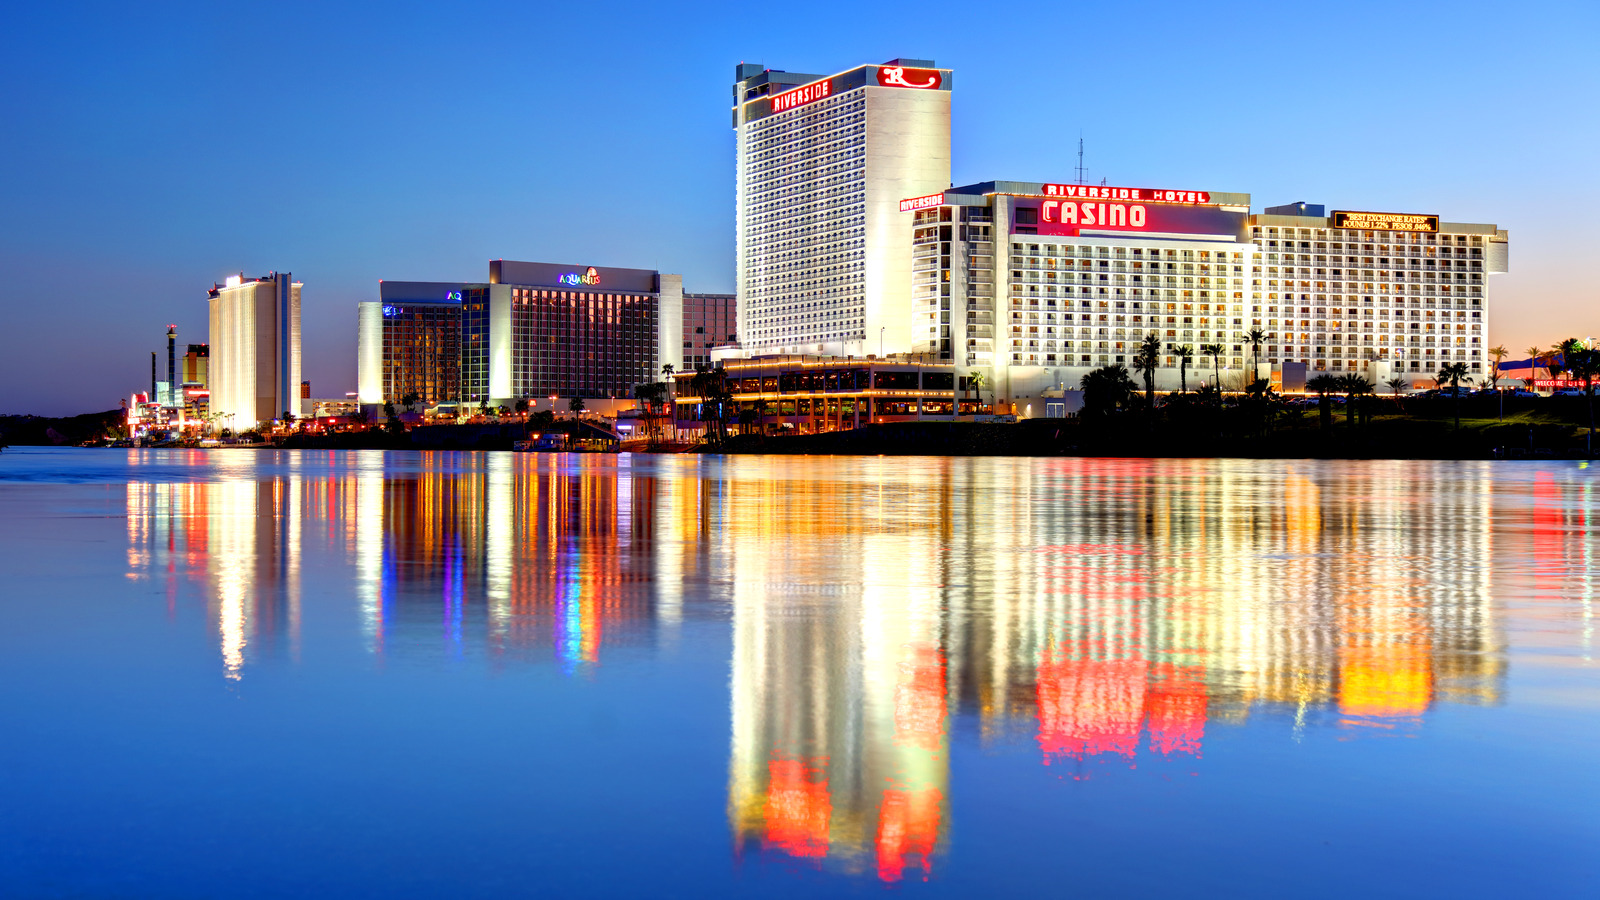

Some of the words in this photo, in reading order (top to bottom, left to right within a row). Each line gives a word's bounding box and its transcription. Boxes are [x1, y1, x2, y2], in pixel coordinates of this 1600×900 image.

[774, 81, 829, 112] RIVERSIDE
[900, 194, 943, 211] RIVERSIDE
[1047, 185, 1140, 200] RIVERSIDE
[1153, 190, 1206, 203] HOTEL
[1042, 200, 1146, 227] CASINO
[1367, 214, 1403, 223] EXCHANGE
[1343, 220, 1370, 228] POUNDS
[1392, 222, 1413, 230] PESOS
[558, 272, 601, 285] AQUARIUS
